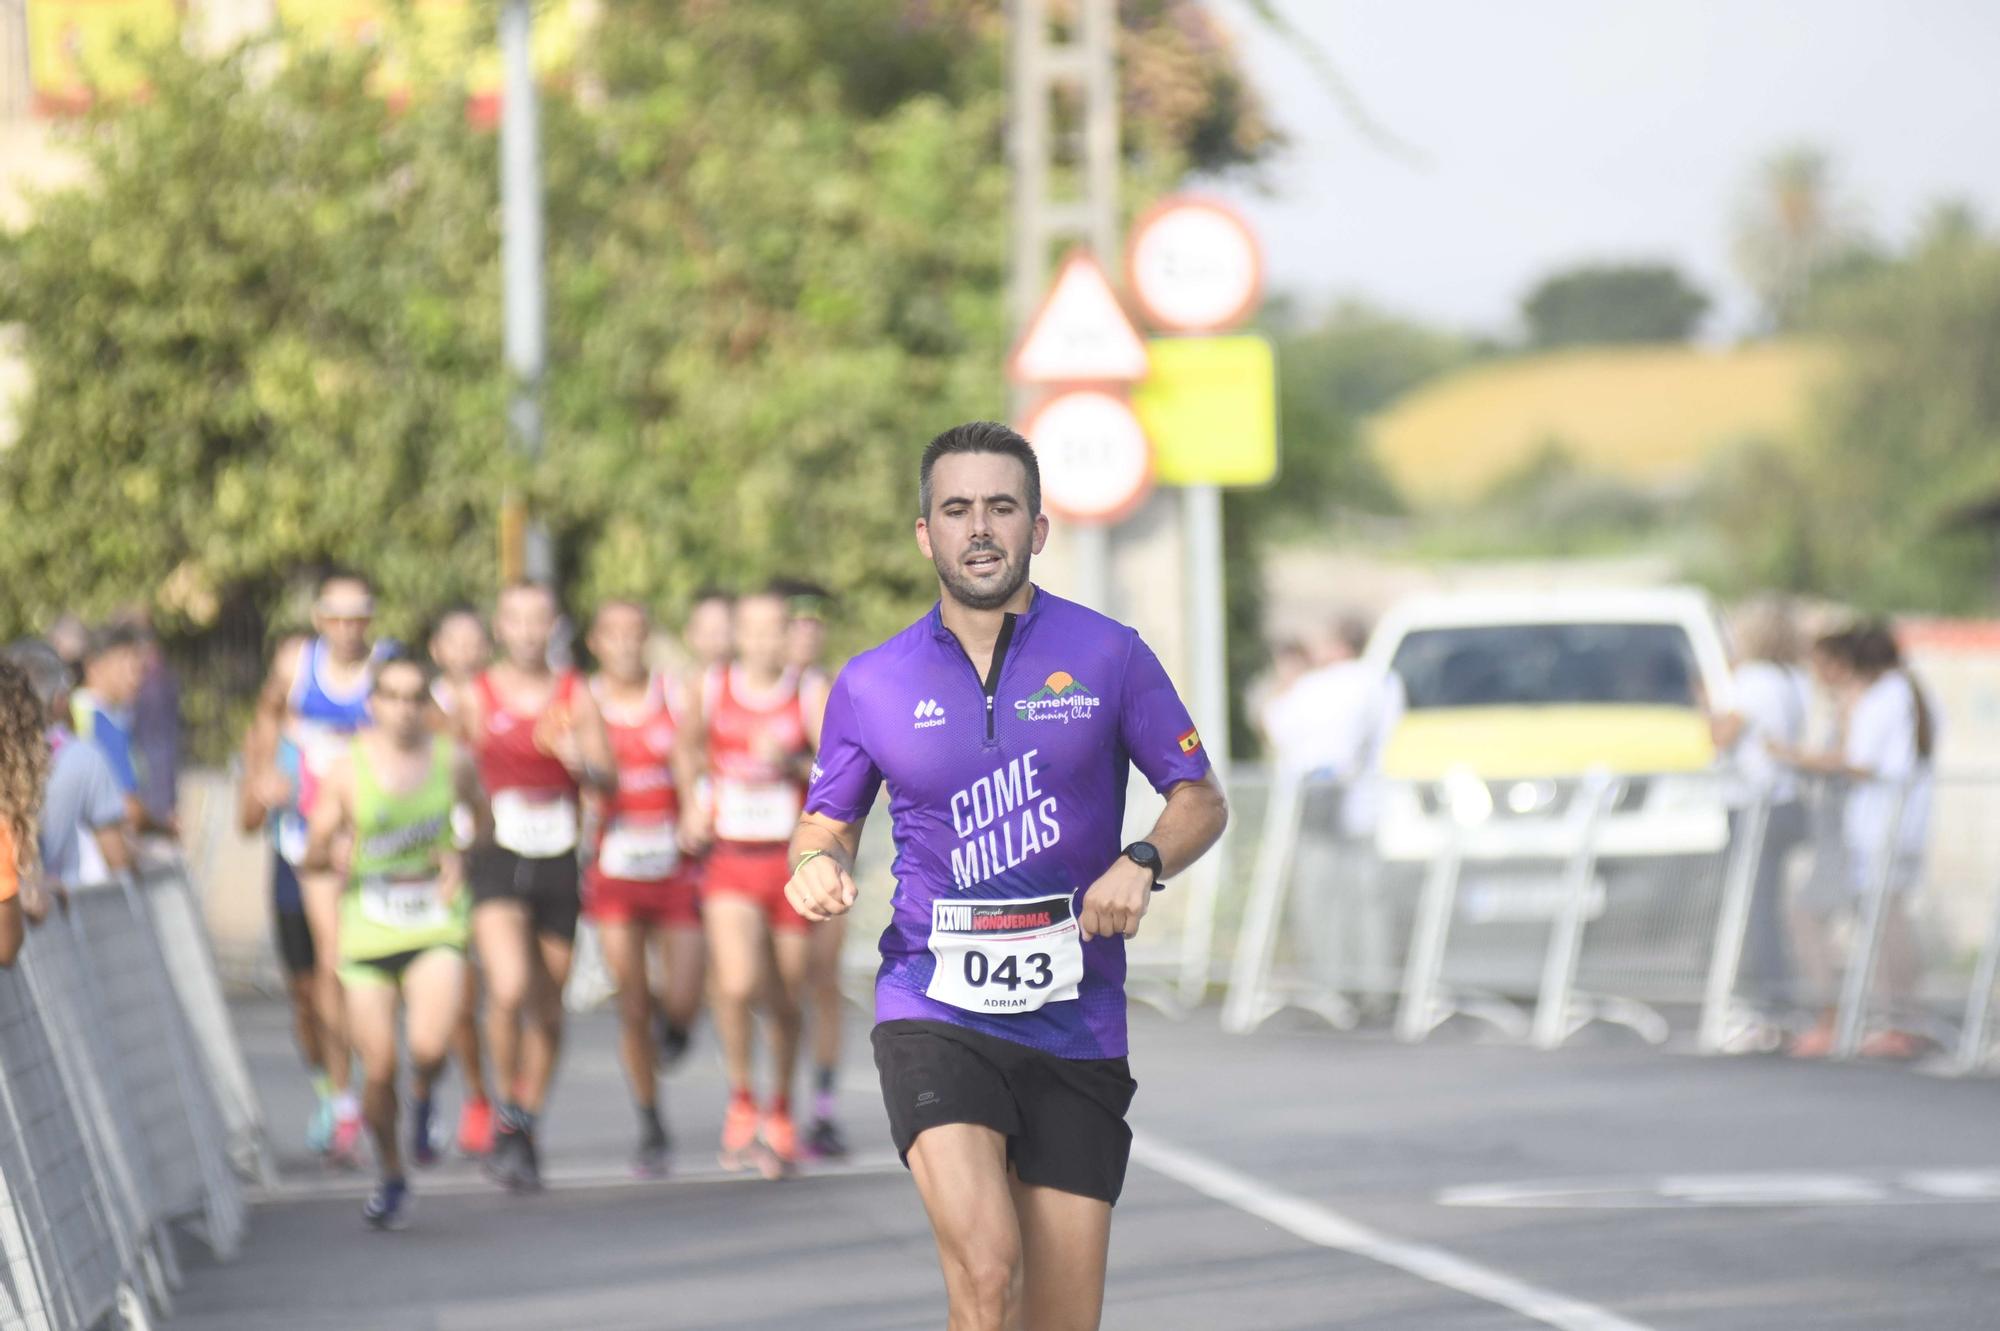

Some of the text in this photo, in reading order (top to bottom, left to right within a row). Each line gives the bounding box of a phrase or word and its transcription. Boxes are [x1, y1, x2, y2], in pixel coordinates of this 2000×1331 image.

[1014, 695, 1100, 710] ComeMillas
[914, 717, 946, 729] mobel
[1028, 706, 1092, 725] Running Club
[950, 749, 1042, 839] COME
[951, 797, 1060, 890] MILLAS
[937, 906, 972, 931] XXVIII
[963, 950, 1053, 991] 043
[983, 998, 1027, 1008] ADRIAN
